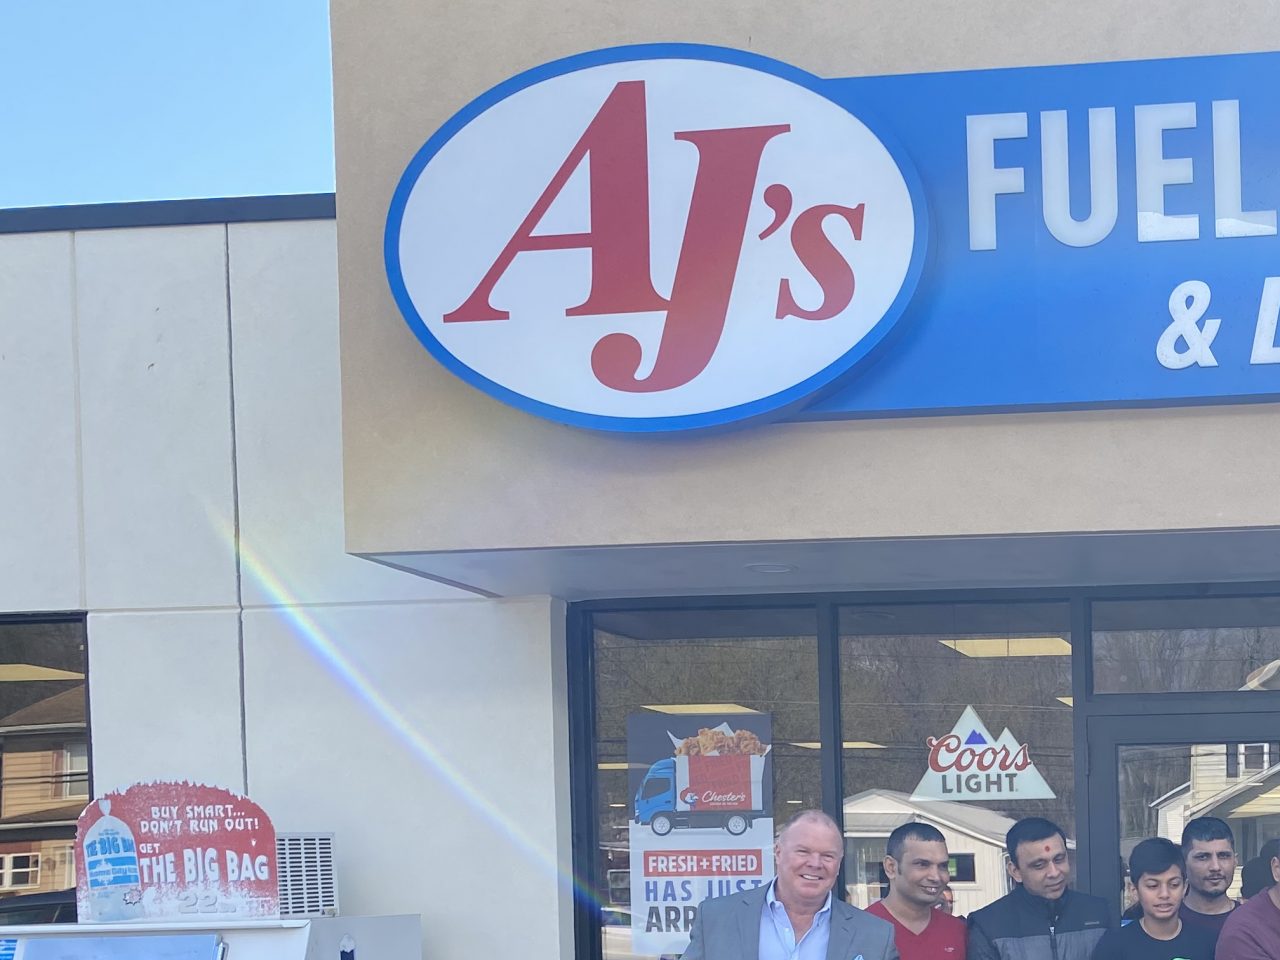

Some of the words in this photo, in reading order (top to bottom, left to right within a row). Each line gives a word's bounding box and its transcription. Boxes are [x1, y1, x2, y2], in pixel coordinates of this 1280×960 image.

[965, 98, 1278, 251] FUEL
[442, 80, 866, 394] AJ's
[1155, 280, 1222, 371] &
[926, 733, 1032, 773] Coors
[941, 773, 1018, 794] LIGHT
[151, 806, 179, 819] BUY
[185, 804, 245, 819] SMART...
[140, 820, 182, 836] DON'T
[189, 819, 218, 834] RUN
[224, 818, 259, 832] OUT!
[139, 843, 160, 854] GET
[139, 852, 176, 883] THE
[183, 847, 218, 882] BIG
[225, 849, 269, 881] BAG
[645, 880, 692, 902] HAS
[645, 905, 698, 932] ARR
